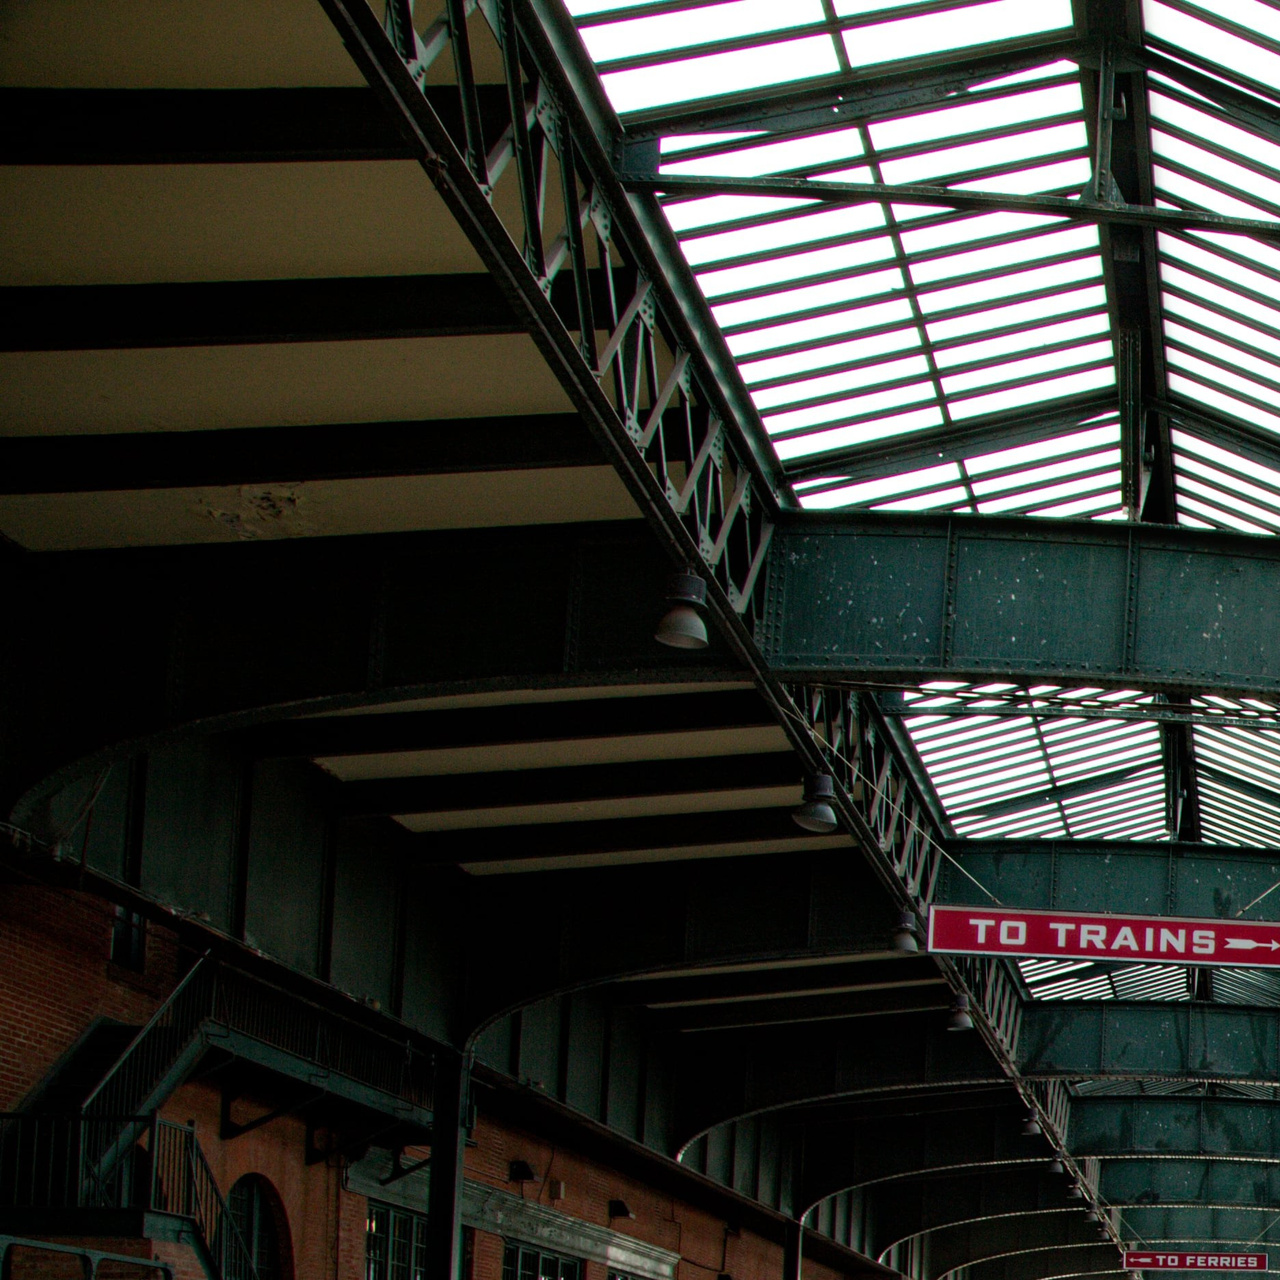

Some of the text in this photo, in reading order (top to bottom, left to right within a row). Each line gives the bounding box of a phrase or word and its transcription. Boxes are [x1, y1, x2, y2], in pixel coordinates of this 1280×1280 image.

[969, 918, 1215, 954] TO TRAINS
[1156, 1255, 1258, 1267] TO FERRIES
